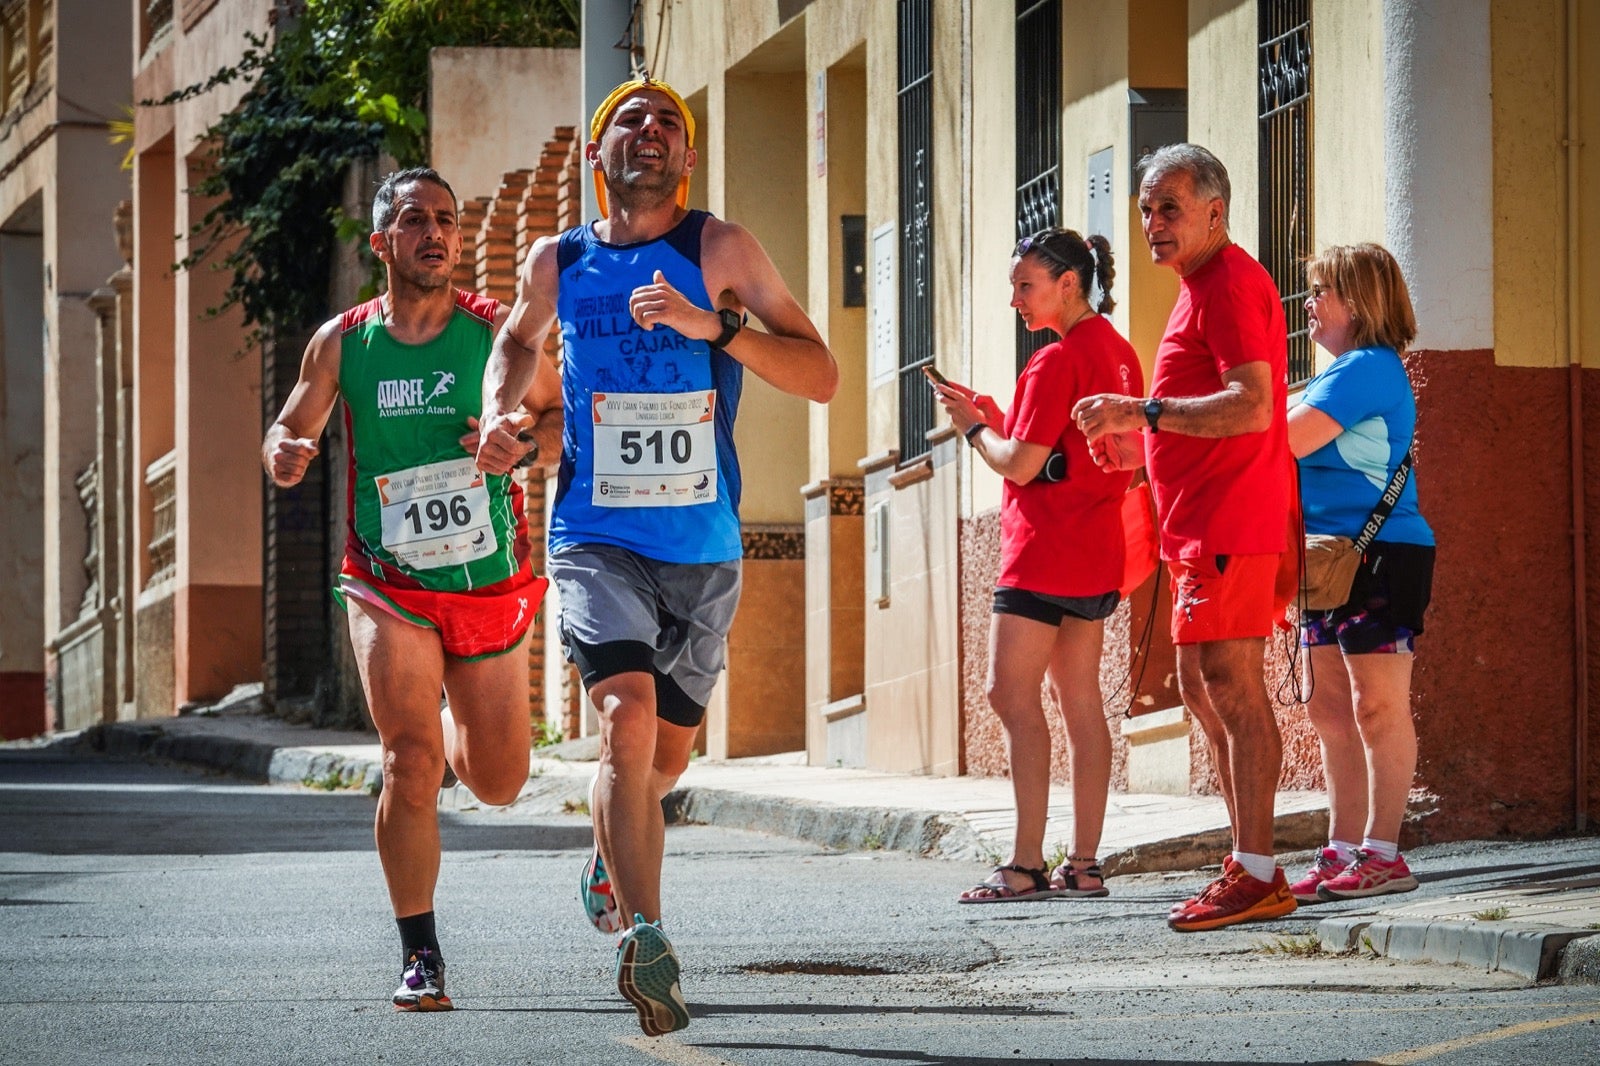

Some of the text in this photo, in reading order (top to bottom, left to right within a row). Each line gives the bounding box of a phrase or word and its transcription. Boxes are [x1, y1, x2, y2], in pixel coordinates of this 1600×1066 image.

[620, 333, 689, 355] CÁJAR
[378, 379, 424, 409] ATARFE
[379, 405, 456, 418] Atletismo Atarfe
[620, 429, 692, 465] 510
[1383, 464, 1409, 506] BIMBA
[404, 494, 472, 535] 196
